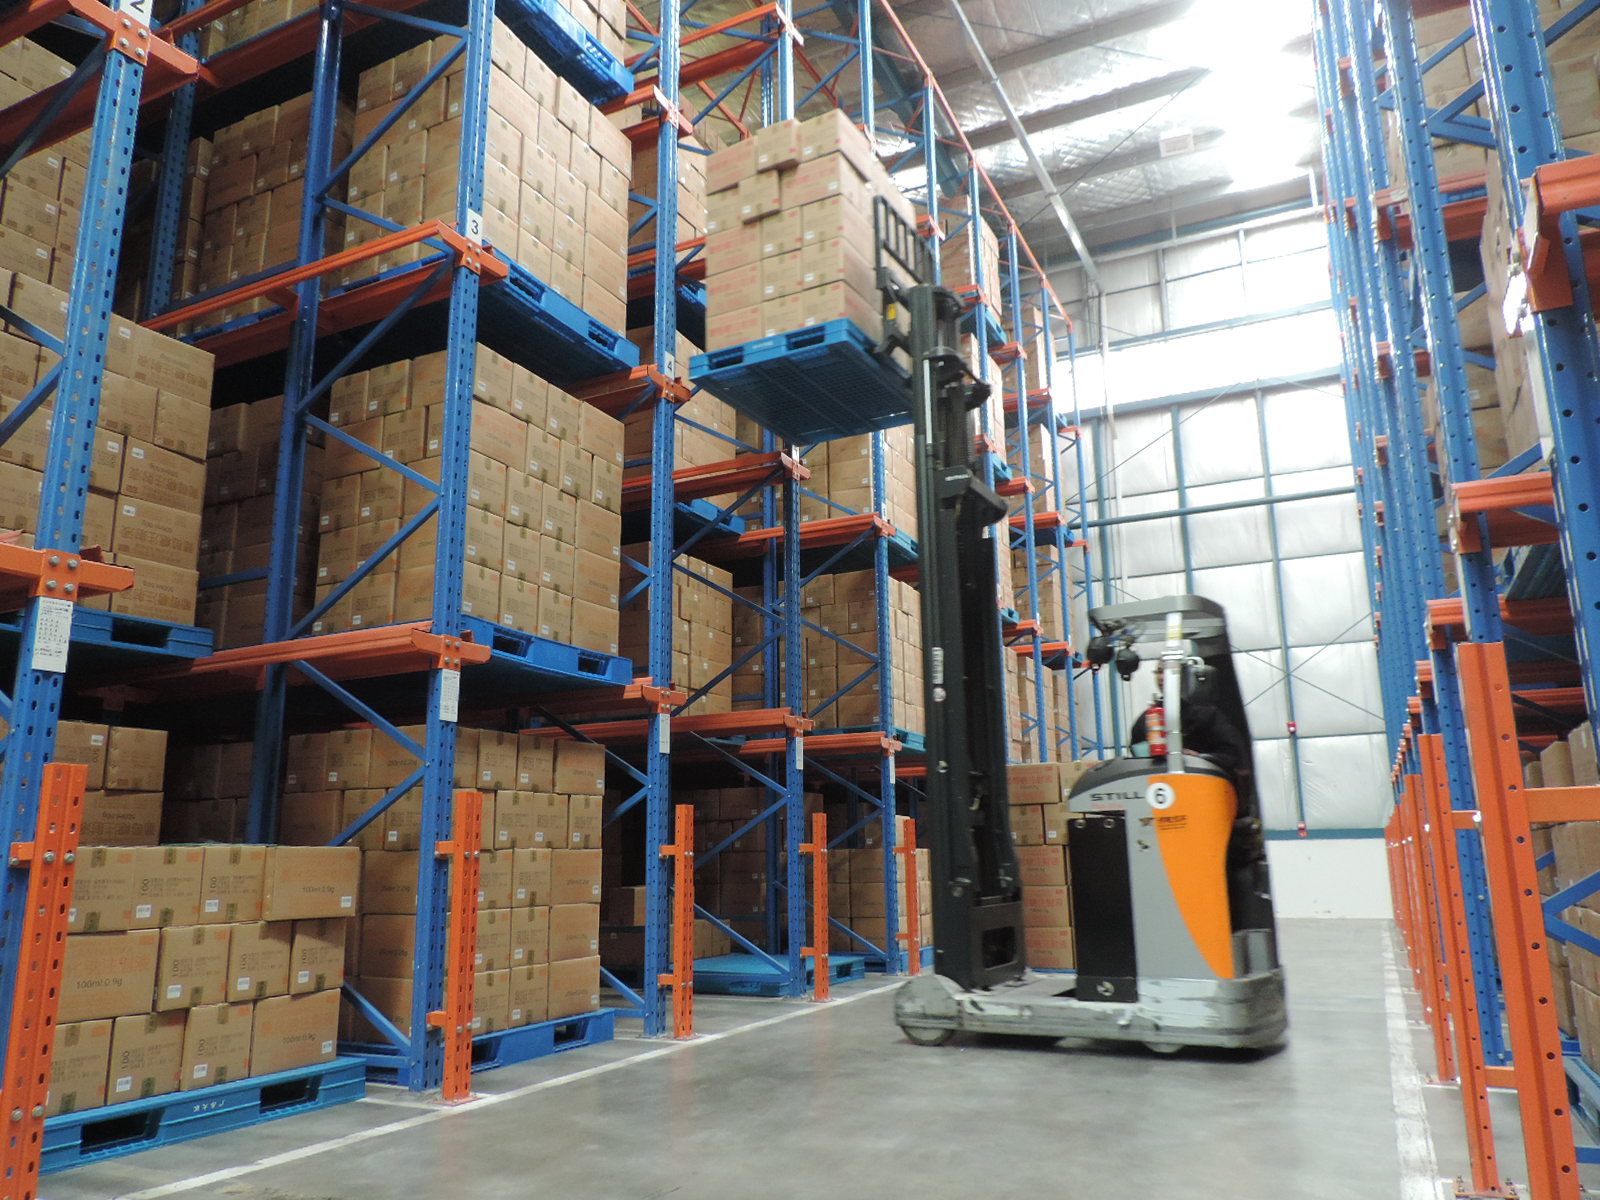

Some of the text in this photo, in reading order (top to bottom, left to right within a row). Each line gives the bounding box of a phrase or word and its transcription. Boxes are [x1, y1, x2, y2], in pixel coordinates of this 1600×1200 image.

[471, 219, 479, 235] 3
[1090, 791, 1145, 801] STILL
[1154, 787, 1166, 804] 6
[141, 878, 149, 896] 100
[209, 876, 217, 893] 100
[171, 960, 179, 977] 100
[121, 1050, 129, 1069] 100
